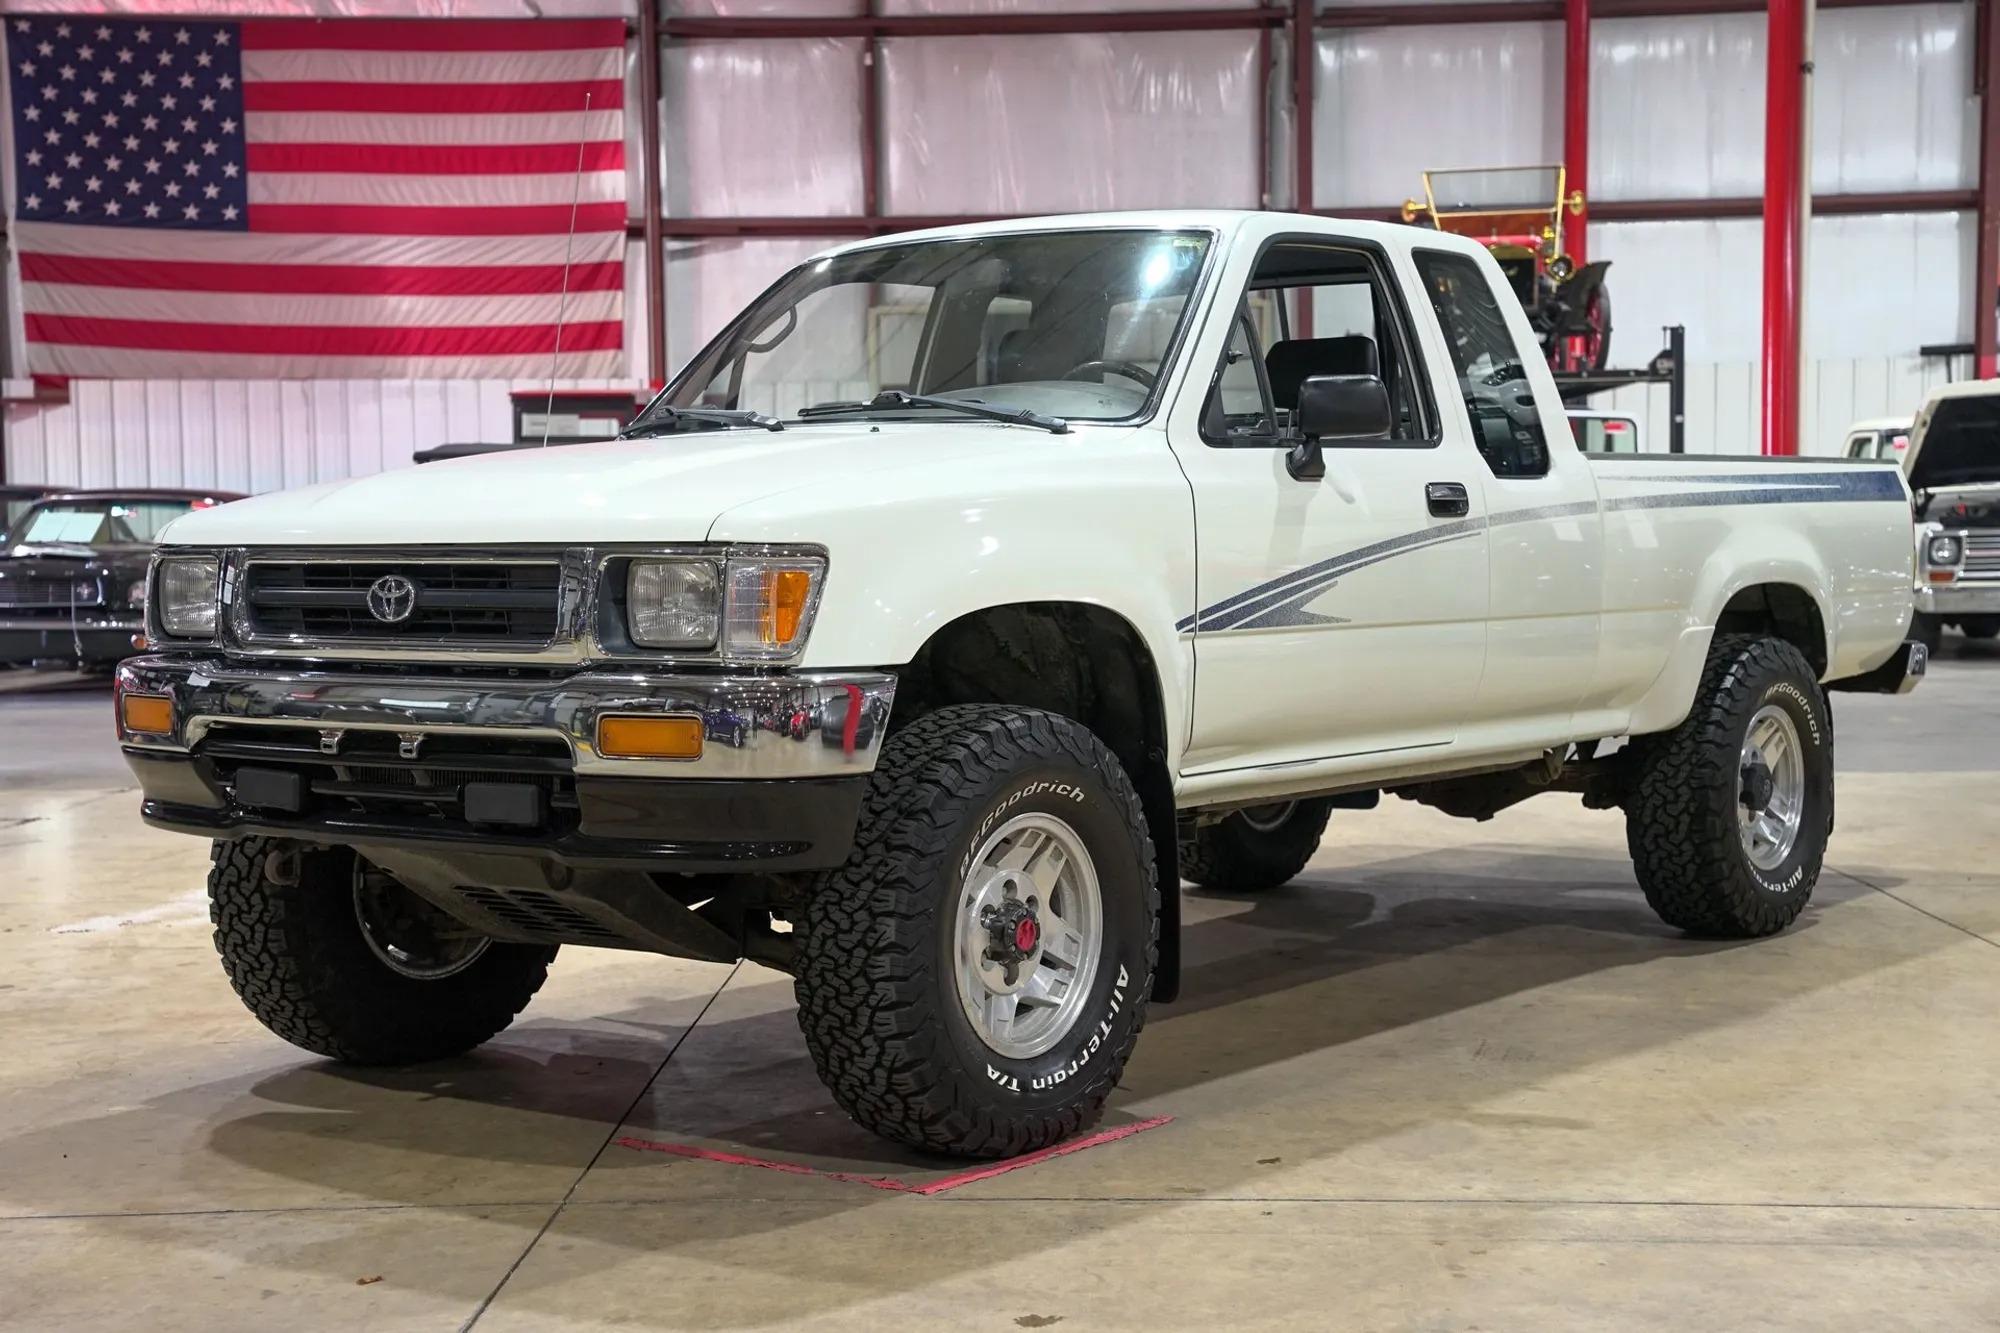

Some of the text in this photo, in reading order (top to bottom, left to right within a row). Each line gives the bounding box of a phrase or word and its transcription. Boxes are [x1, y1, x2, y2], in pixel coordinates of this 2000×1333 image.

[960, 780, 1085, 881] BFGoodrich
[987, 963, 1129, 1092] All-Terrain T/A
